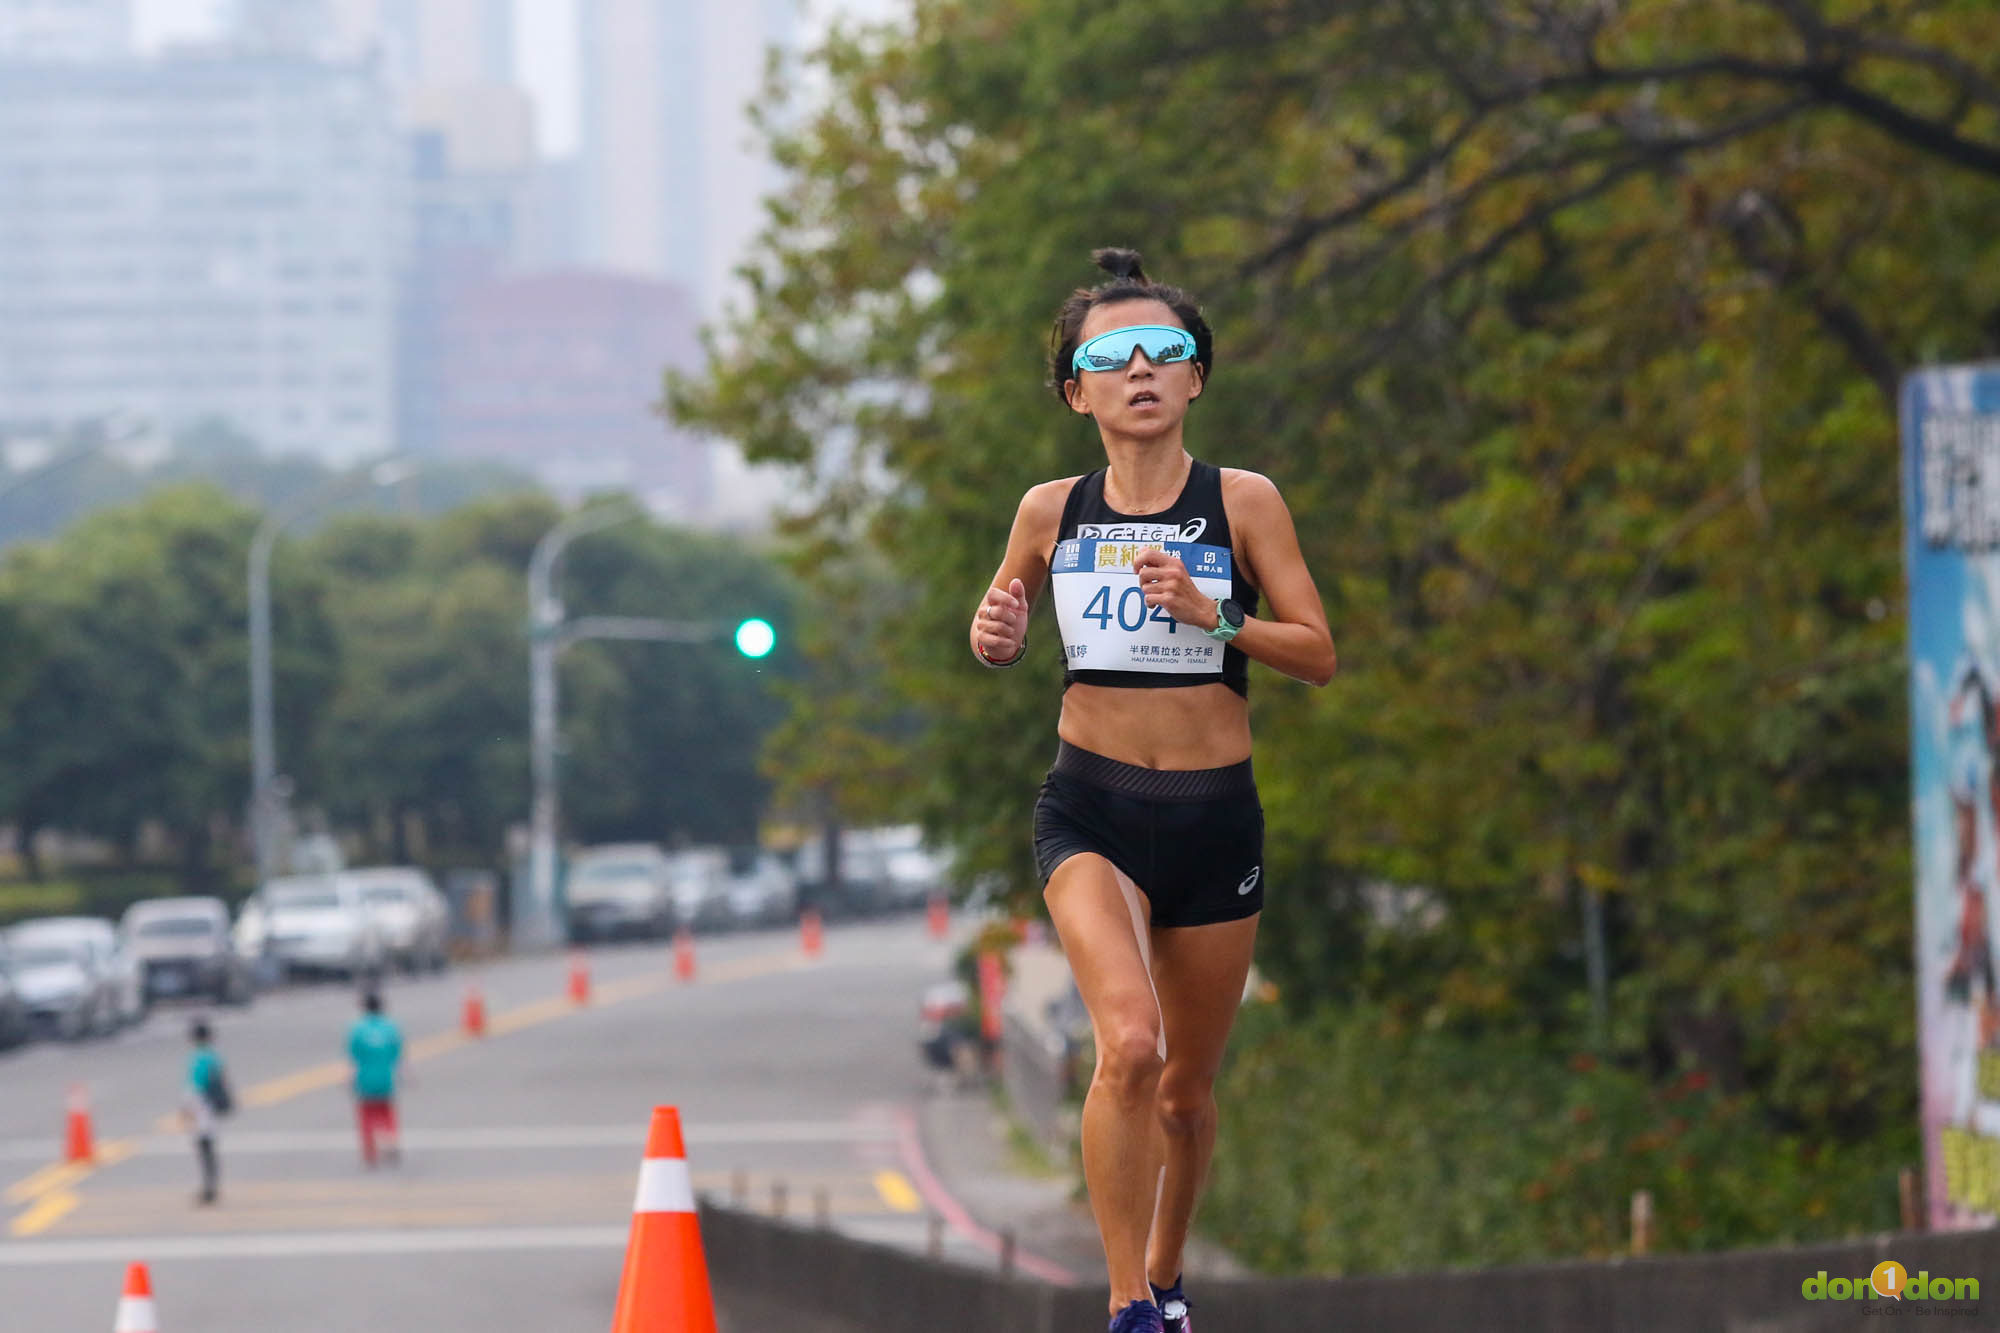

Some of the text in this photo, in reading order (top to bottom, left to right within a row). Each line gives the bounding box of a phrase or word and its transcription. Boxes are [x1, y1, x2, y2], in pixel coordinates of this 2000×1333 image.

[1098, 544, 1162, 567] 農純
[1082, 586, 1178, 633] 404
[1130, 645, 1213, 656] 半程馬拉松 女子組
